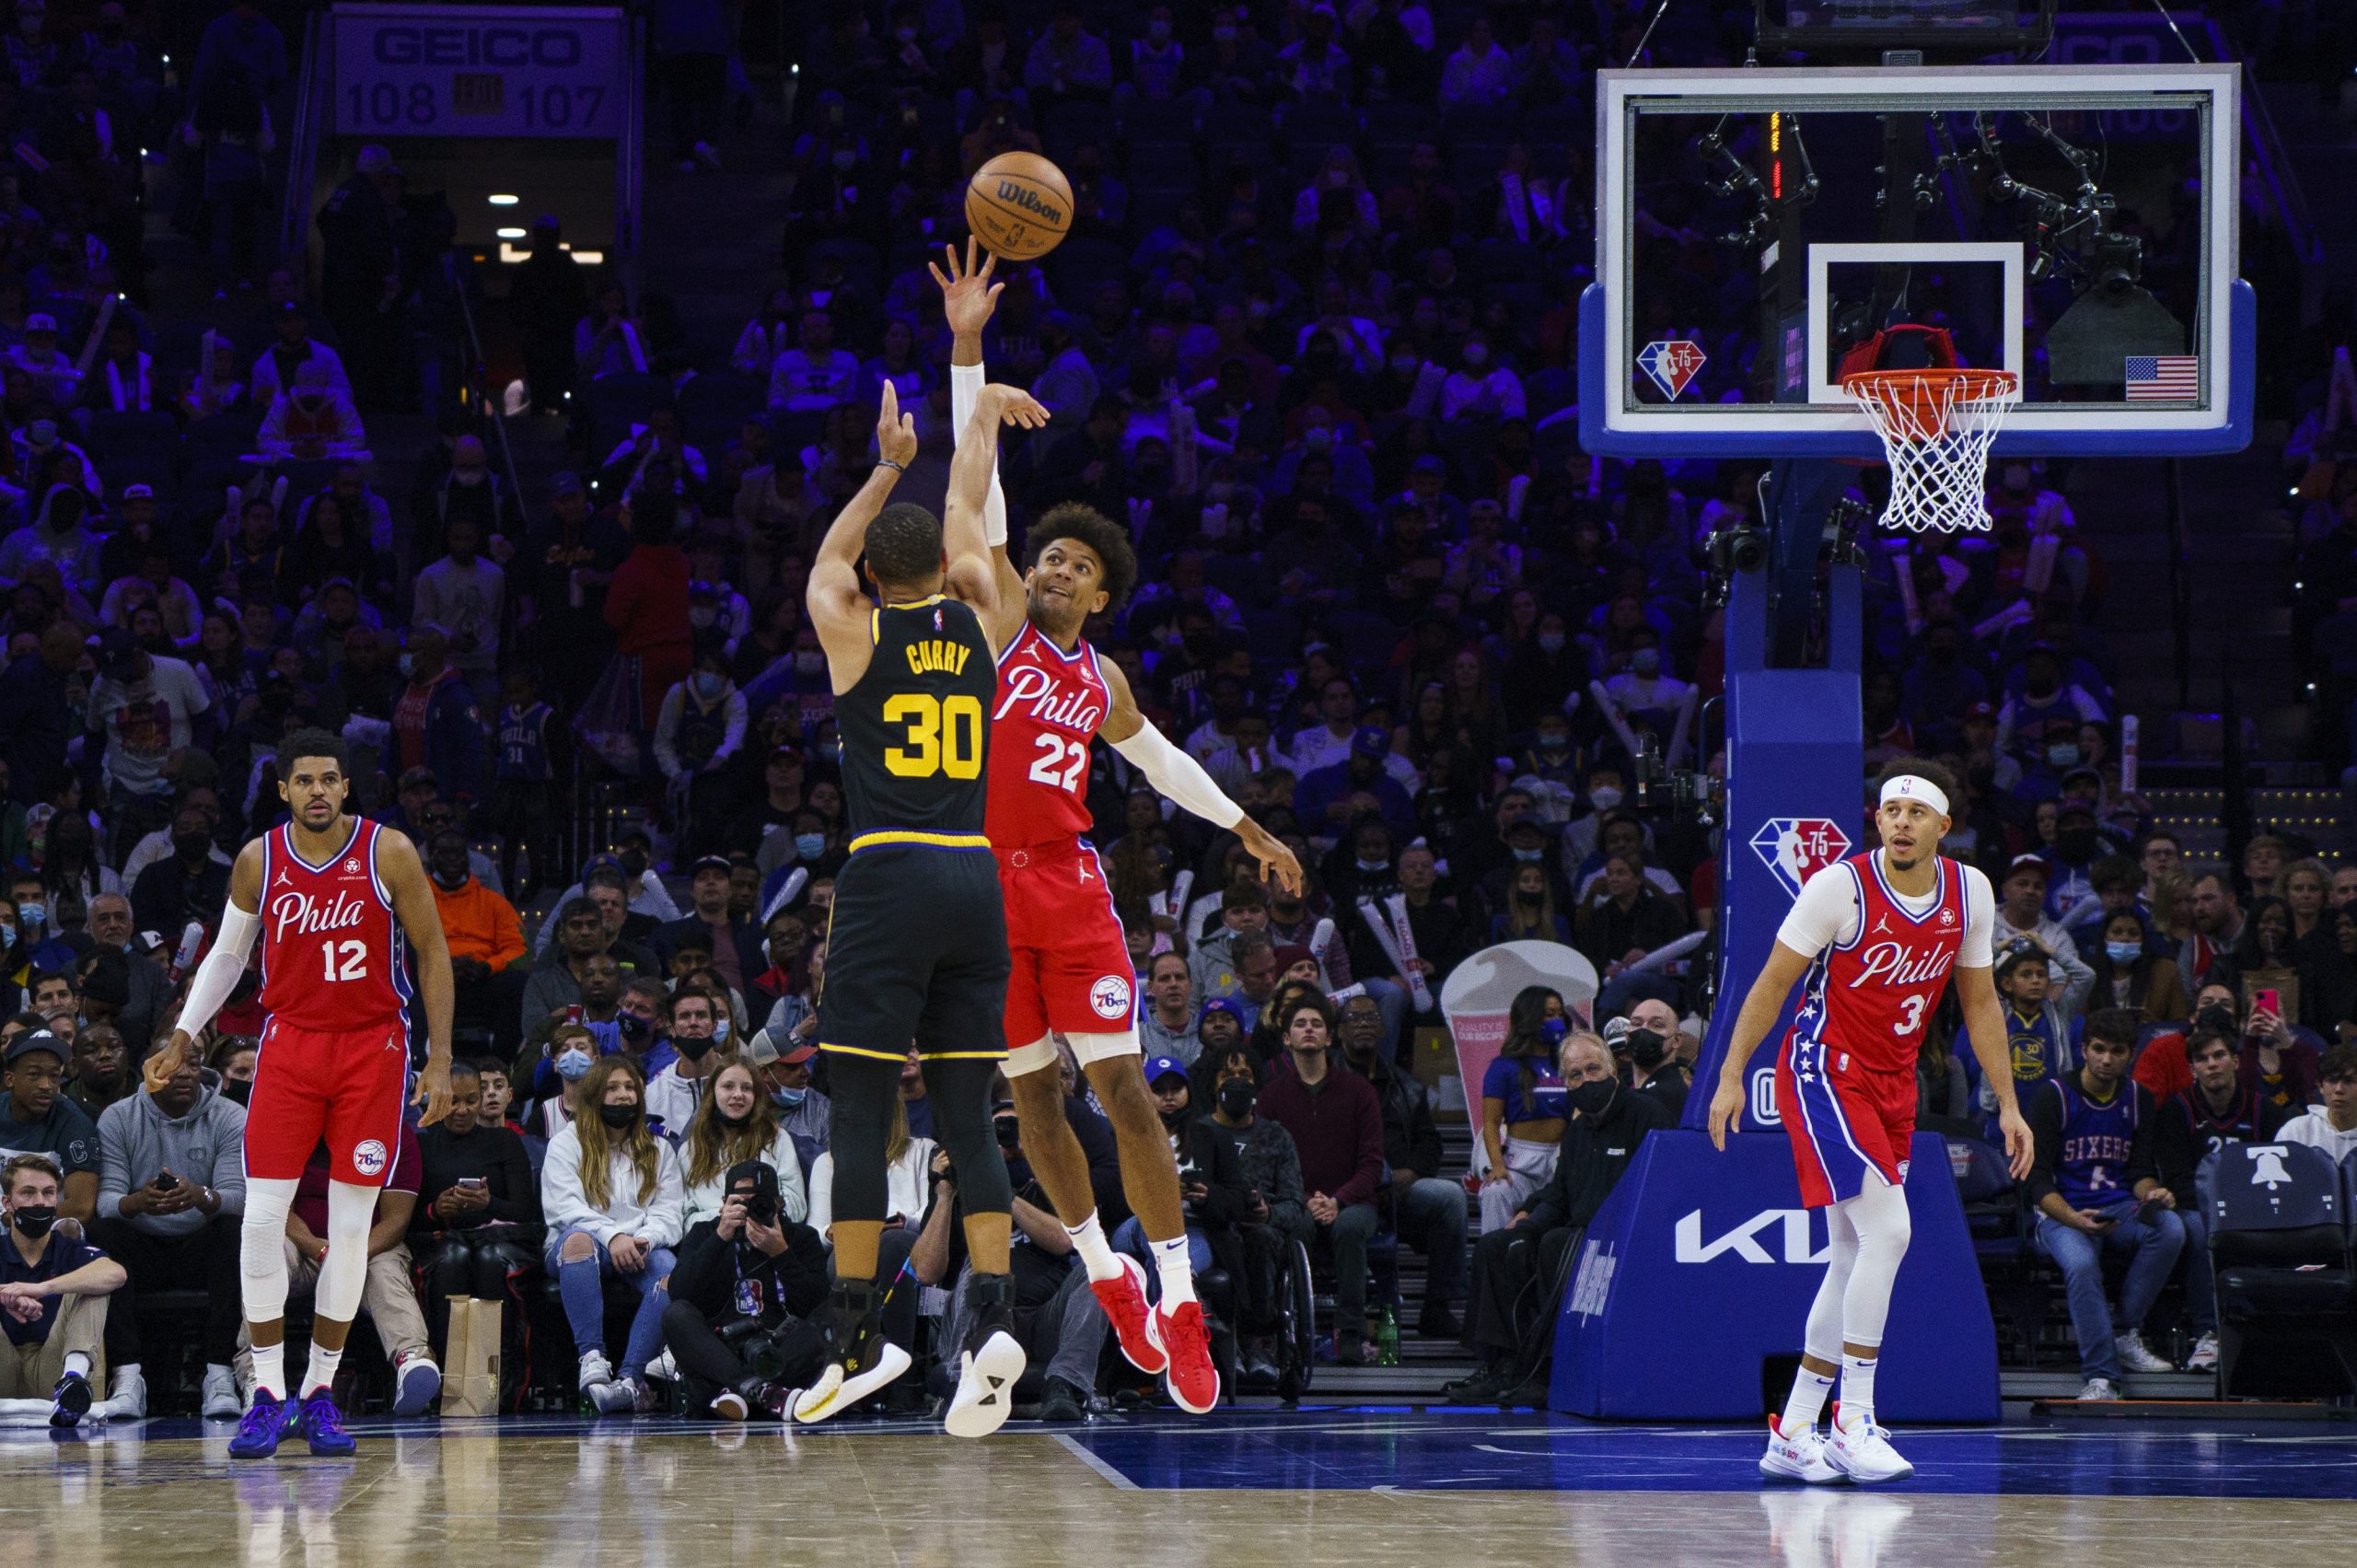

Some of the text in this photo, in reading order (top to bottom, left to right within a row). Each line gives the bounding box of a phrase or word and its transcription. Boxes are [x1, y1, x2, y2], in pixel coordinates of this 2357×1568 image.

[373, 27, 581, 67] GEICO
[347, 81, 436, 126] 108
[519, 85, 605, 129] 107
[997, 180, 1062, 225] Wilson
[1678, 349, 1691, 366] 75
[905, 640, 971, 676] CURRY
[993, 665, 1100, 733] Phila
[883, 693, 983, 780] 30
[1028, 732, 1087, 793] 22
[1809, 831, 1829, 856] 75
[272, 889, 365, 944] Phila
[322, 939, 367, 982] 12
[1849, 941, 1956, 988] Phila
[2026, 1043, 2039, 1055] 30
[2063, 1135, 2133, 1163] SIXERS
